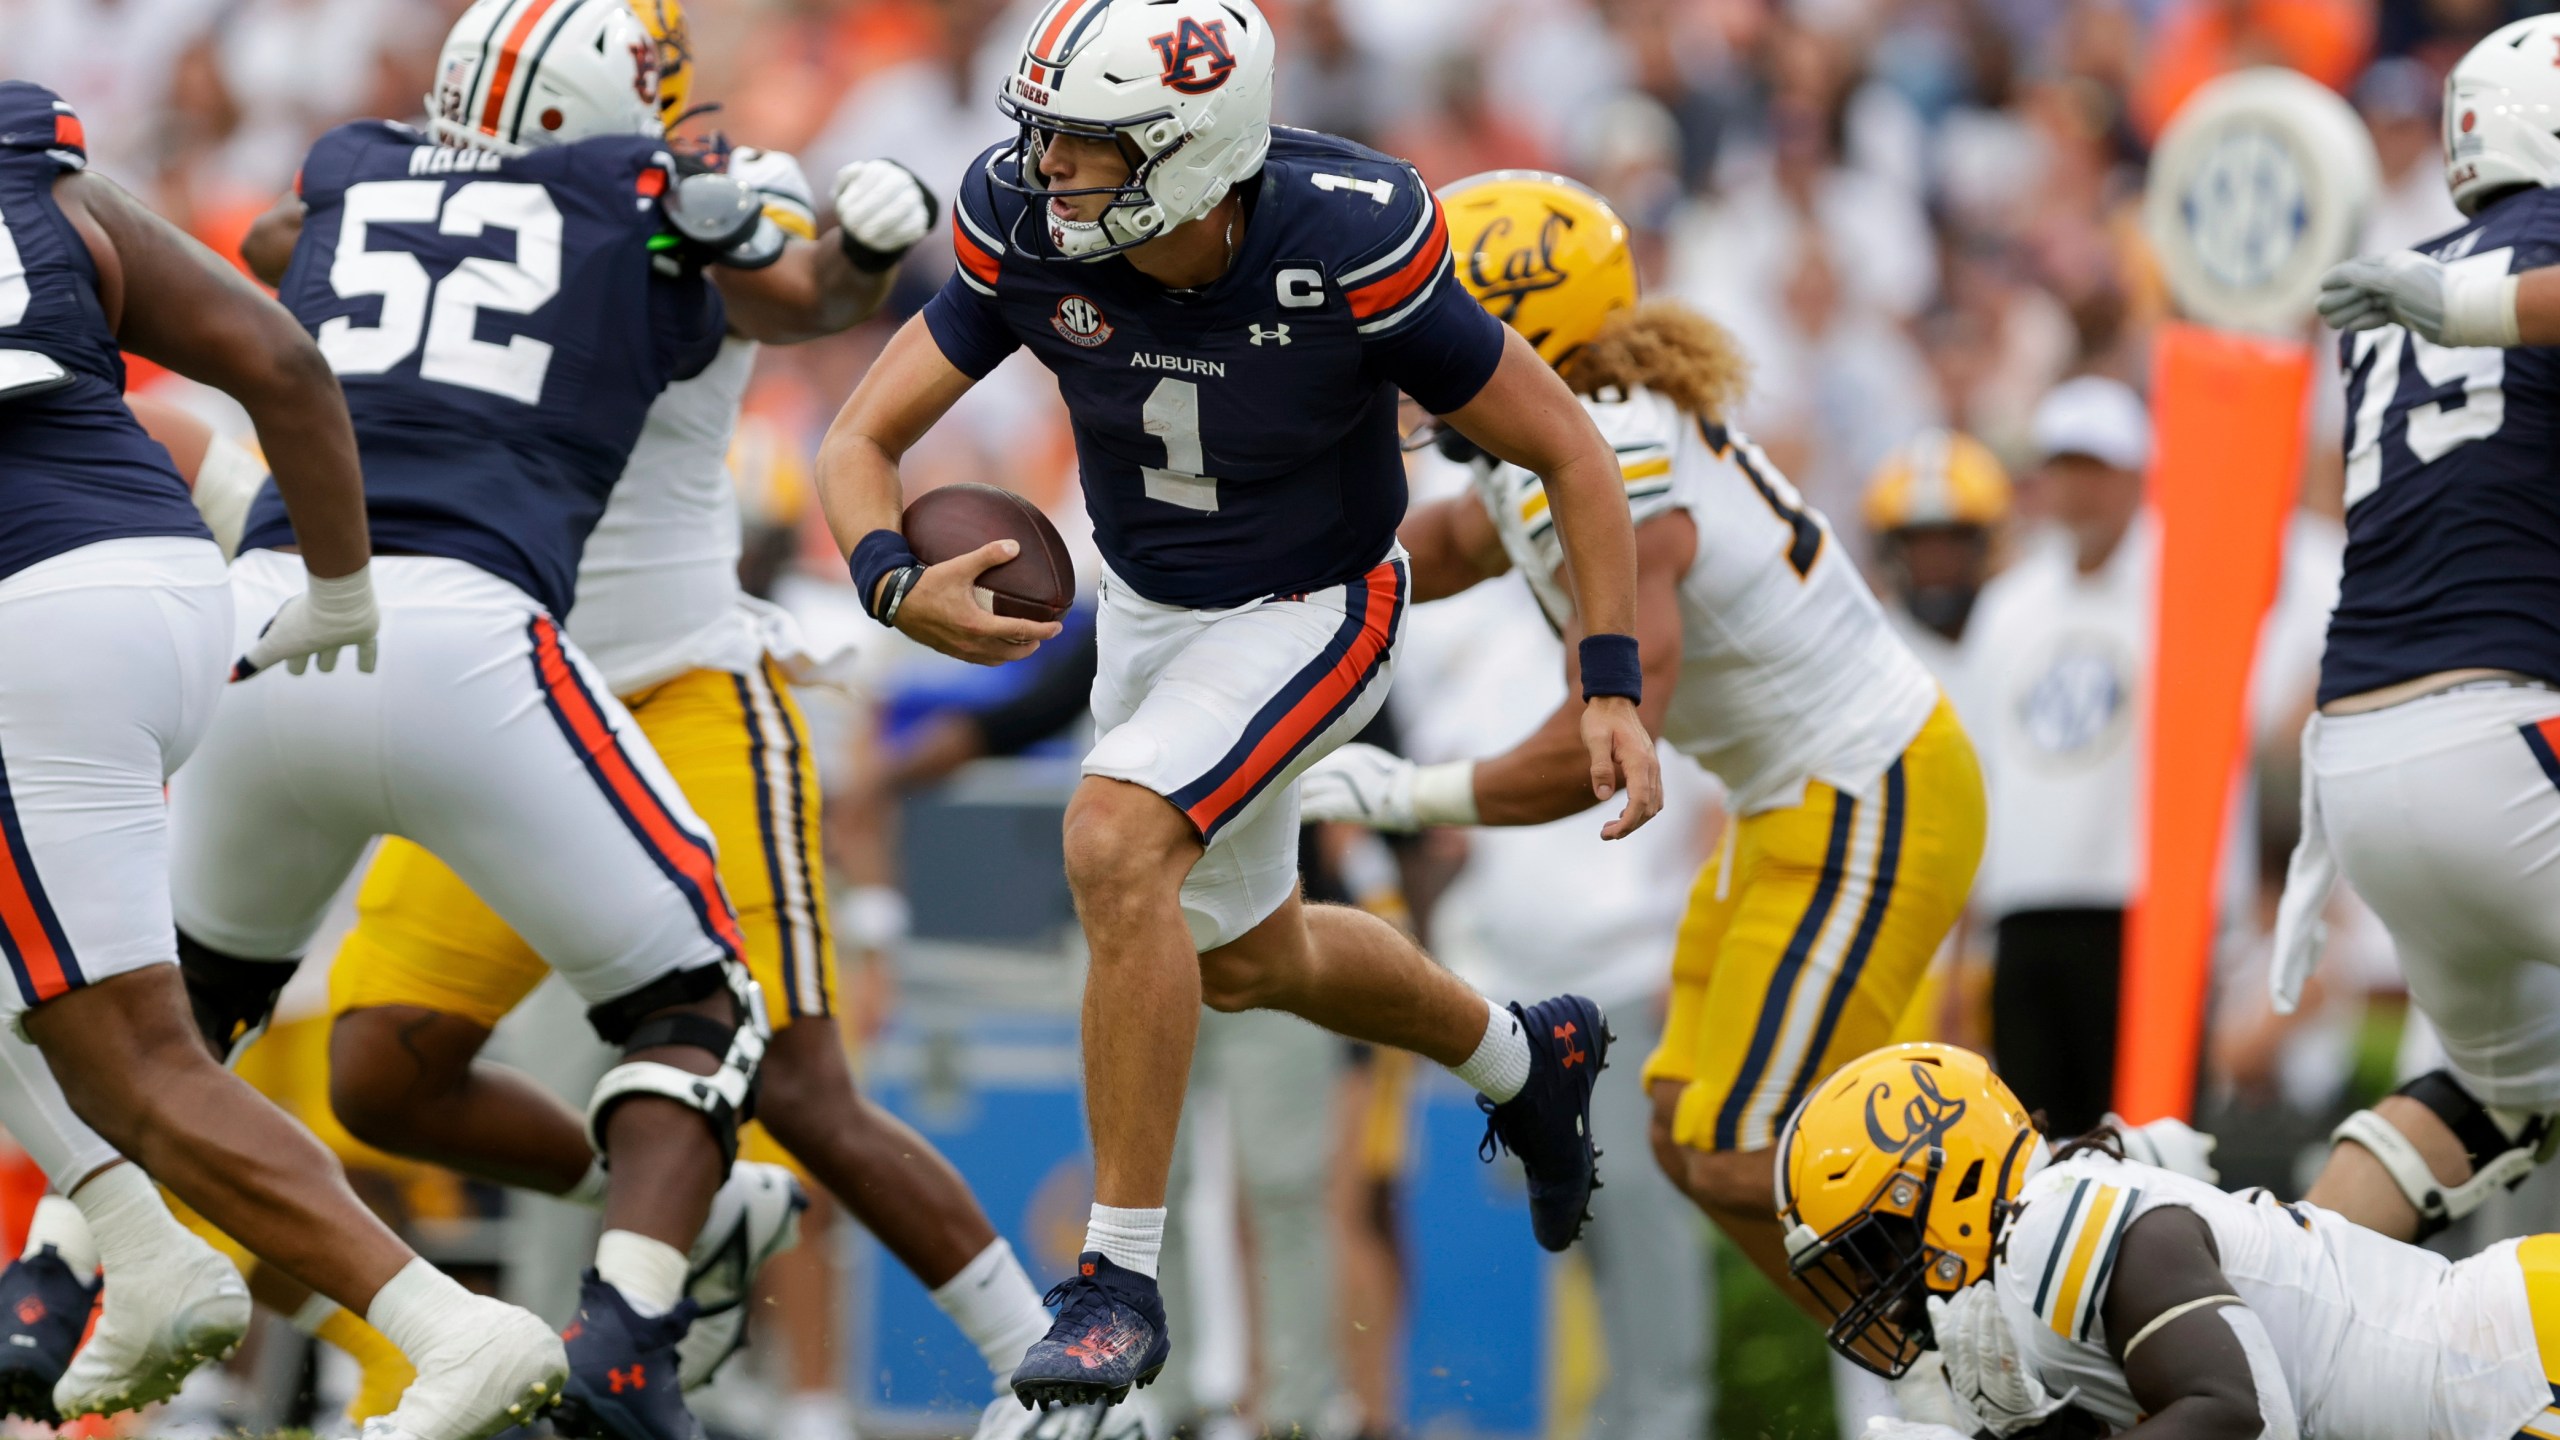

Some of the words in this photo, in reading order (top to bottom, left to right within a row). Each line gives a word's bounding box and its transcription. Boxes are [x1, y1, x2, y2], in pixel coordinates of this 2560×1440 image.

[1016, 79, 1049, 107] TIGERS
[1311, 172, 1394, 205] 1
[1469, 212, 1569, 325] Cal
[318, 180, 563, 406] 52
[1275, 268, 1325, 308] C
[1061, 297, 1100, 334] SEC
[1058, 325, 1106, 345] GRADUATE
[1130, 351, 1226, 377] AUBURN
[1139, 376, 1219, 511] 1
[1865, 1063, 1967, 1169] Cal
